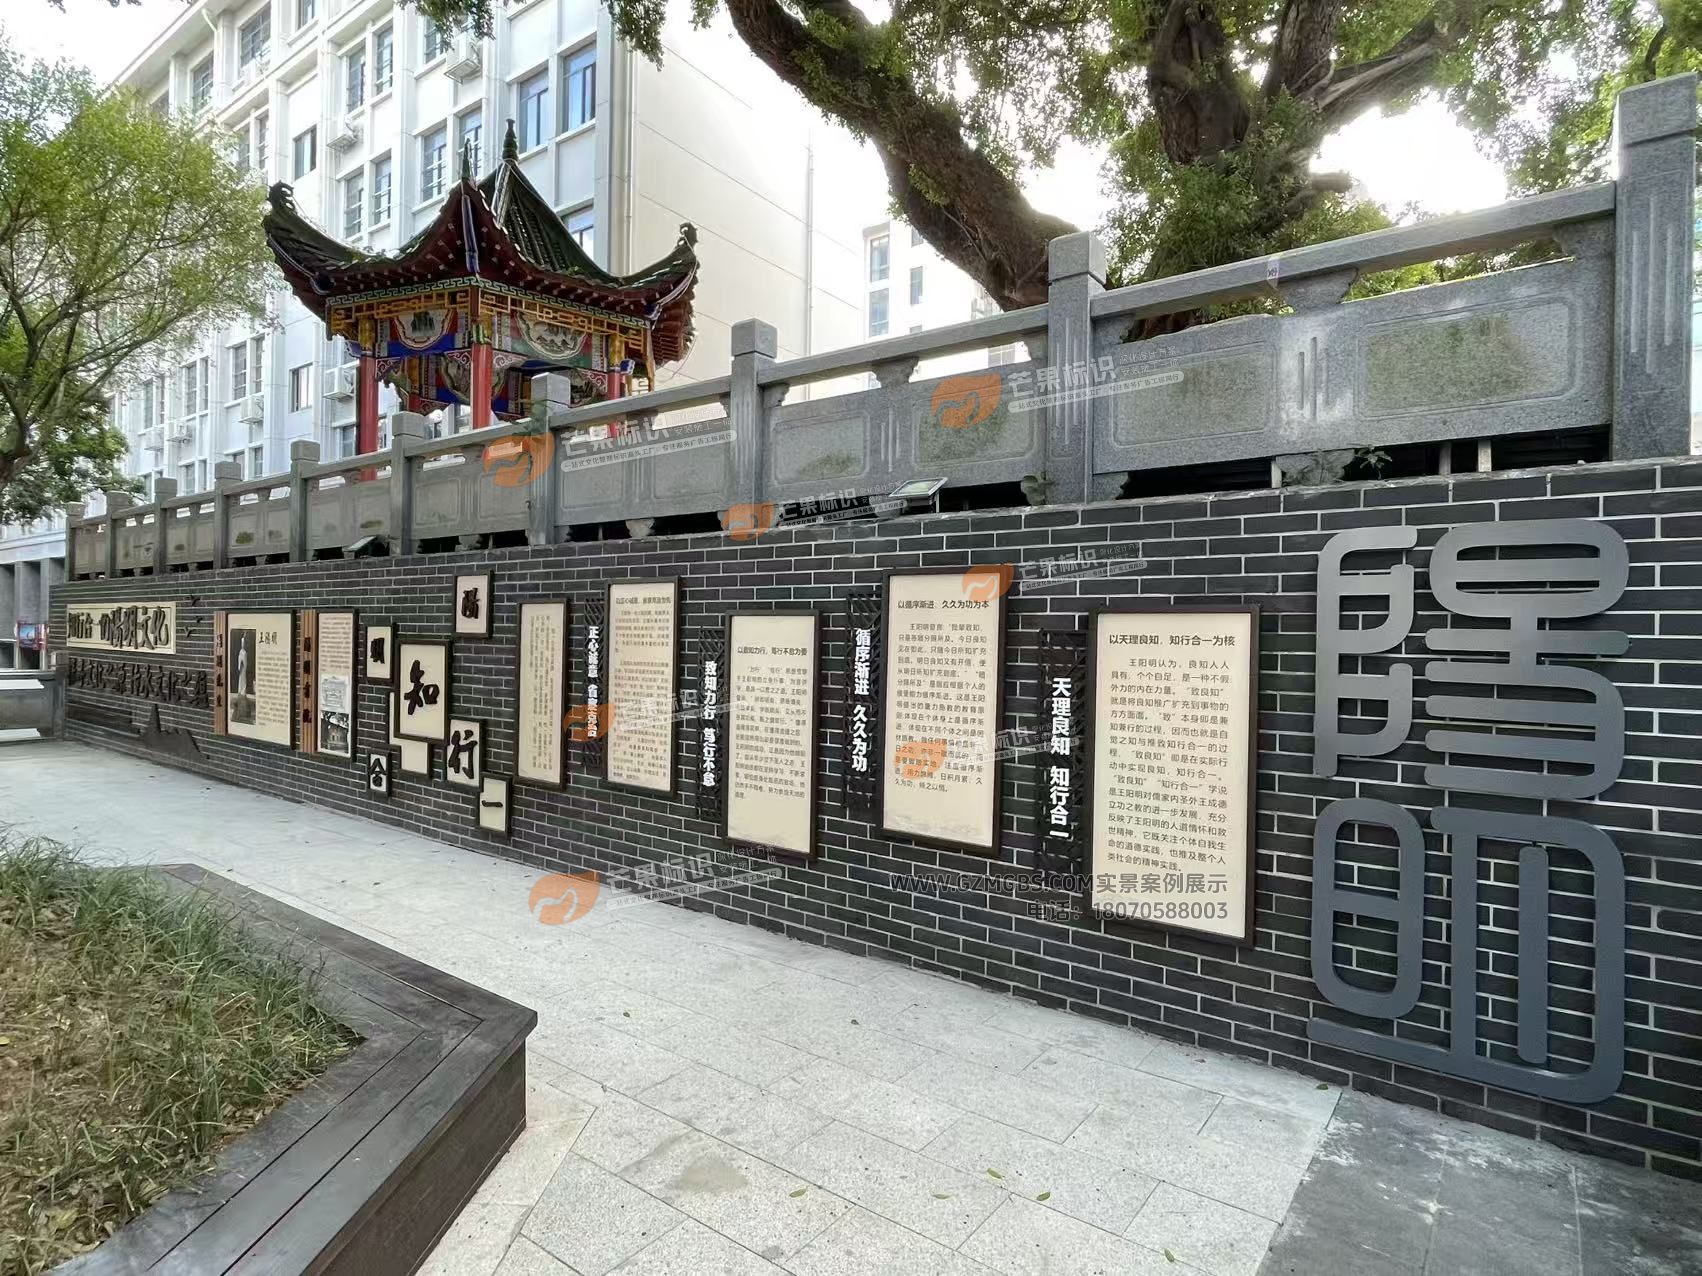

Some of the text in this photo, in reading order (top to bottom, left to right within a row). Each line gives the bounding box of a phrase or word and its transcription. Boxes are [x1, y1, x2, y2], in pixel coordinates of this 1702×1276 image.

[1109, 634, 1235, 646] 以天理良知，知行合一为核
[404, 659, 440, 716] 知
[703, 660, 718, 721] 致知力行
[851, 628, 871, 773] 循序渐进 久久为功
[370, 757, 387, 788] 合
[448, 729, 478, 780] 行
[1049, 677, 1072, 839] 天理良知 知行合一
[481, 799, 503, 808] 一
